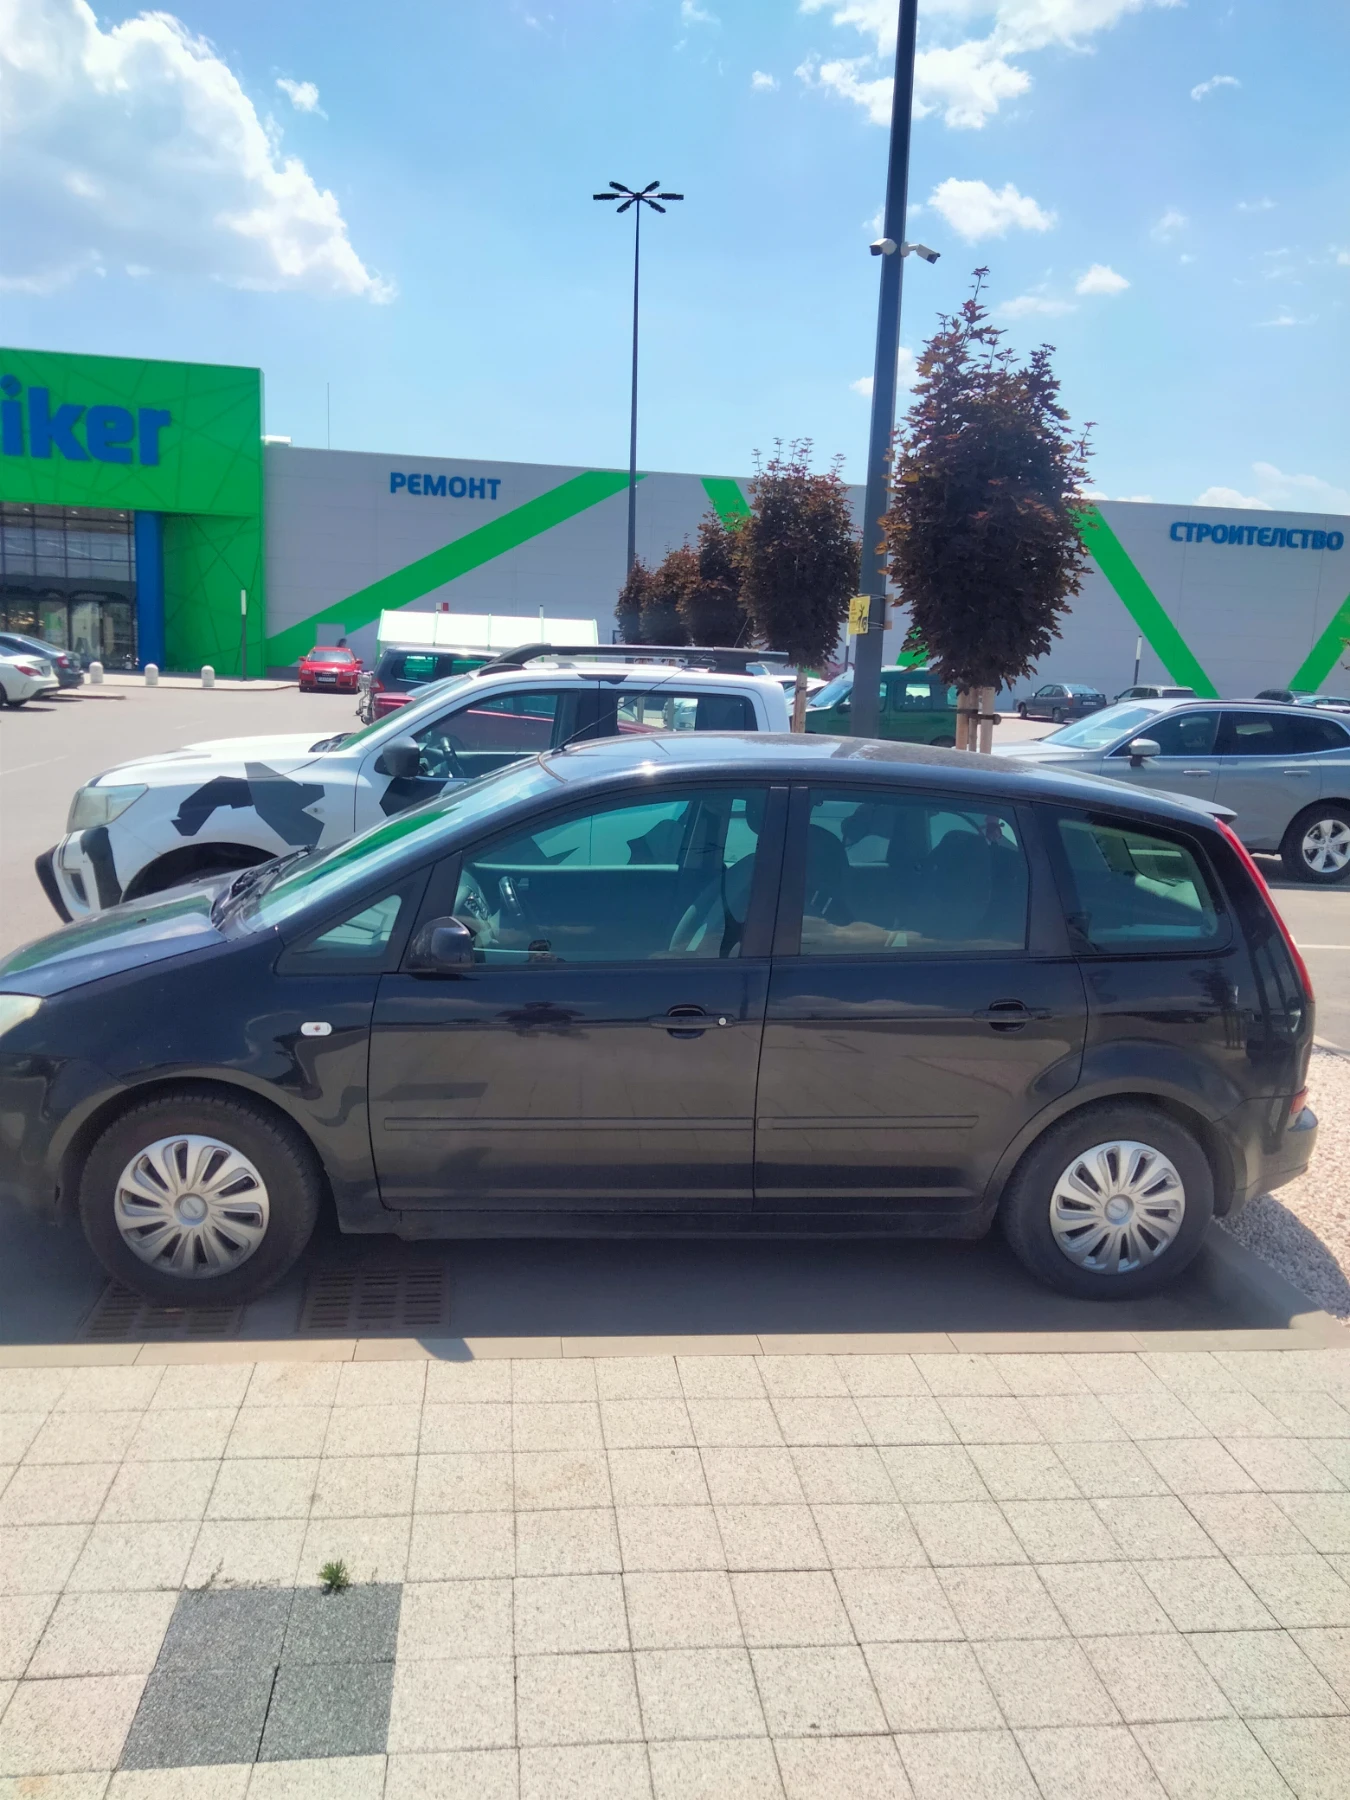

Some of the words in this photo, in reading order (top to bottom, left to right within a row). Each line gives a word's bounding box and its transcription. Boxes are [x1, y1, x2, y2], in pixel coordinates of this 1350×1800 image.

[0, 373, 172, 466] iker
[390, 471, 501, 500] РЕМОНТ
[1170, 521, 1345, 551] СТРОИТЕЛСТВО
